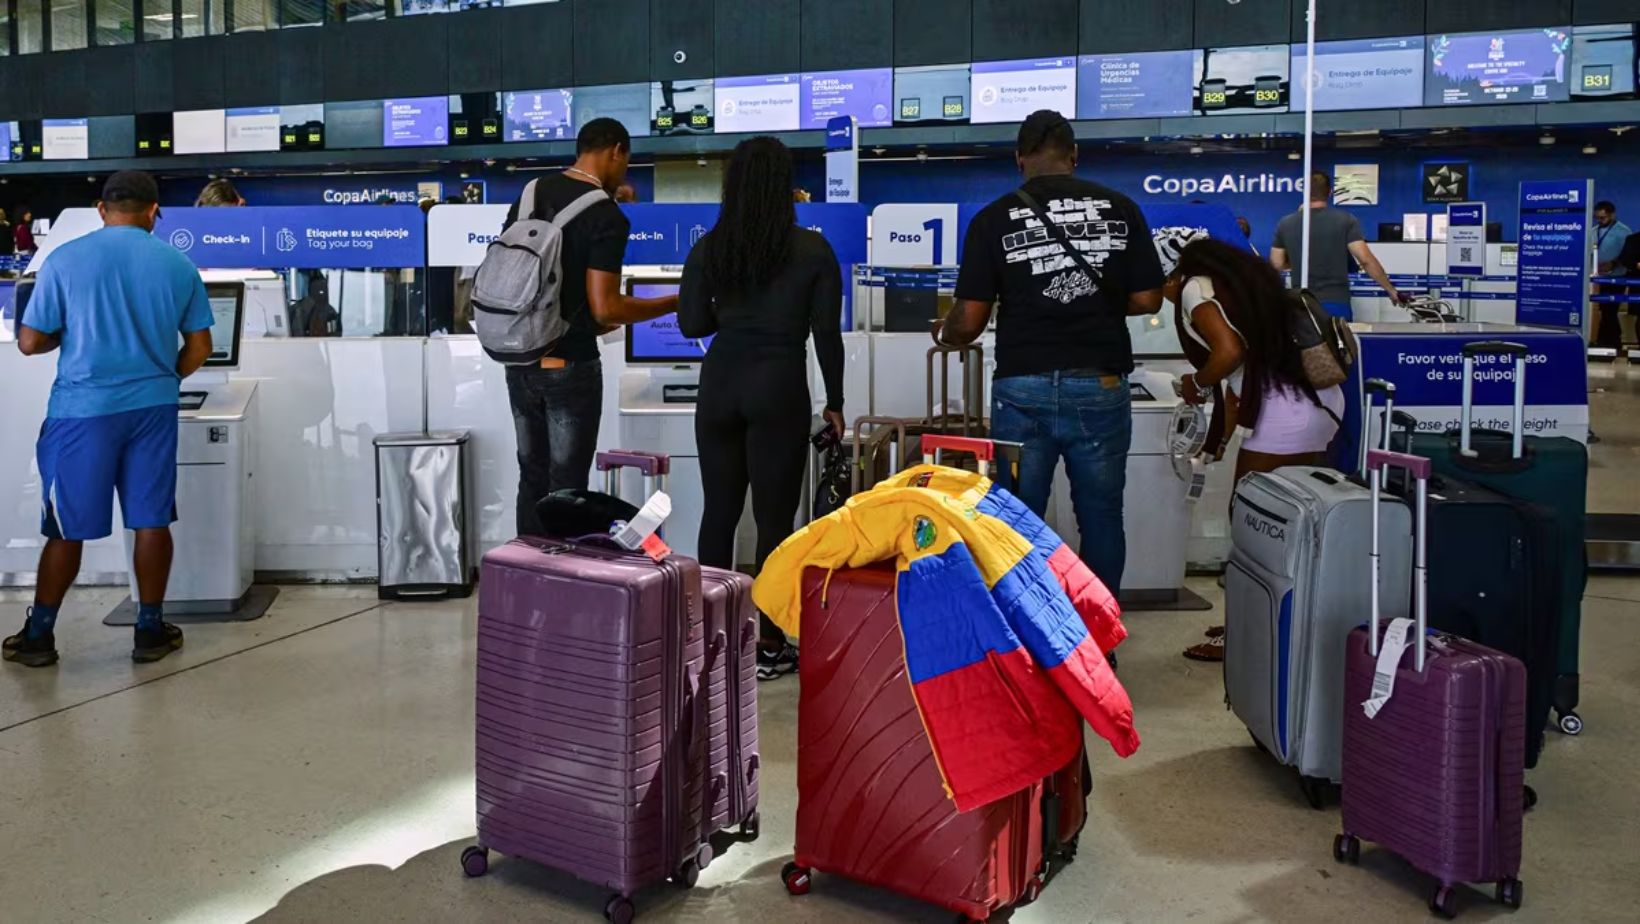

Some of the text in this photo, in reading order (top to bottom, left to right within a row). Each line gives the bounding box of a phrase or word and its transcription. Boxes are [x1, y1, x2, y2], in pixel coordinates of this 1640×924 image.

[1329, 70, 1360, 78] Entrega
[1376, 68, 1412, 76] Equipaje
[1584, 75, 1609, 87] B31
[1000, 86, 1026, 94] Entrega
[1038, 84, 1067, 92] Equipaje
[1204, 92, 1225, 103] B29
[1256, 90, 1278, 100] B30
[902, 106, 920, 116] B27
[944, 104, 962, 113] B28
[658, 118, 672, 126] B25
[692, 116, 708, 124] B26
[1143, 174, 1304, 196] CopaAirline
[1526, 192, 1568, 202] CopaAirlines
[1008, 197, 1112, 220] is this
[1523, 222, 1582, 231] Revisa el tamaño
[306, 228, 408, 239] Etiquete su equipaje
[630, 232, 664, 240] eck-In
[1002, 220, 1128, 251] HEVEN
[202, 234, 250, 244] Check-In
[890, 218, 943, 266] Paso 1
[308, 240, 373, 250] Tag your bag
[1398, 352, 1548, 366] Favor verique el eso
[1426, 368, 1516, 382] de su quipaj
[1446, 418, 1484, 430] chck
[1488, 418, 1510, 430] the
[1524, 418, 1558, 432] eight
[1244, 513, 1285, 542] NAUTICA
